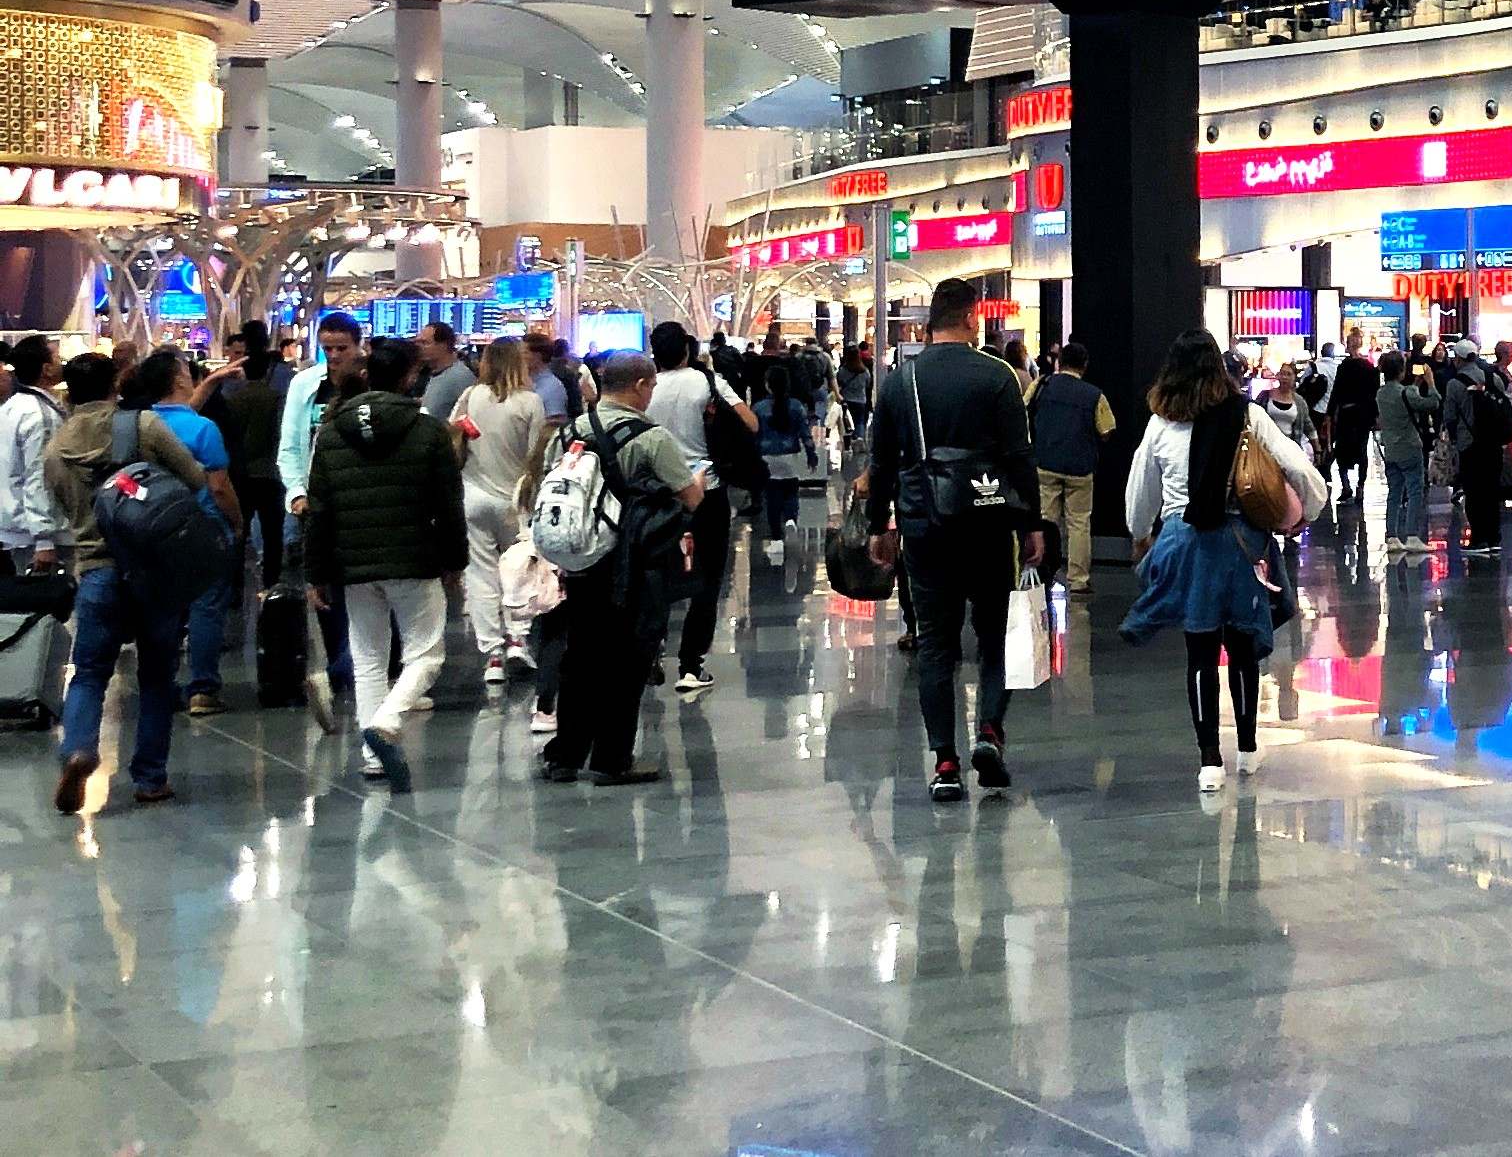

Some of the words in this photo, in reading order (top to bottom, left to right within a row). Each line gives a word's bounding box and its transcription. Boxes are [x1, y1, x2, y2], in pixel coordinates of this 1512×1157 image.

[1008, 91, 1048, 129] DUTY
[1392, 272, 1457, 301] DUTY
[974, 495, 1005, 506] adidas
